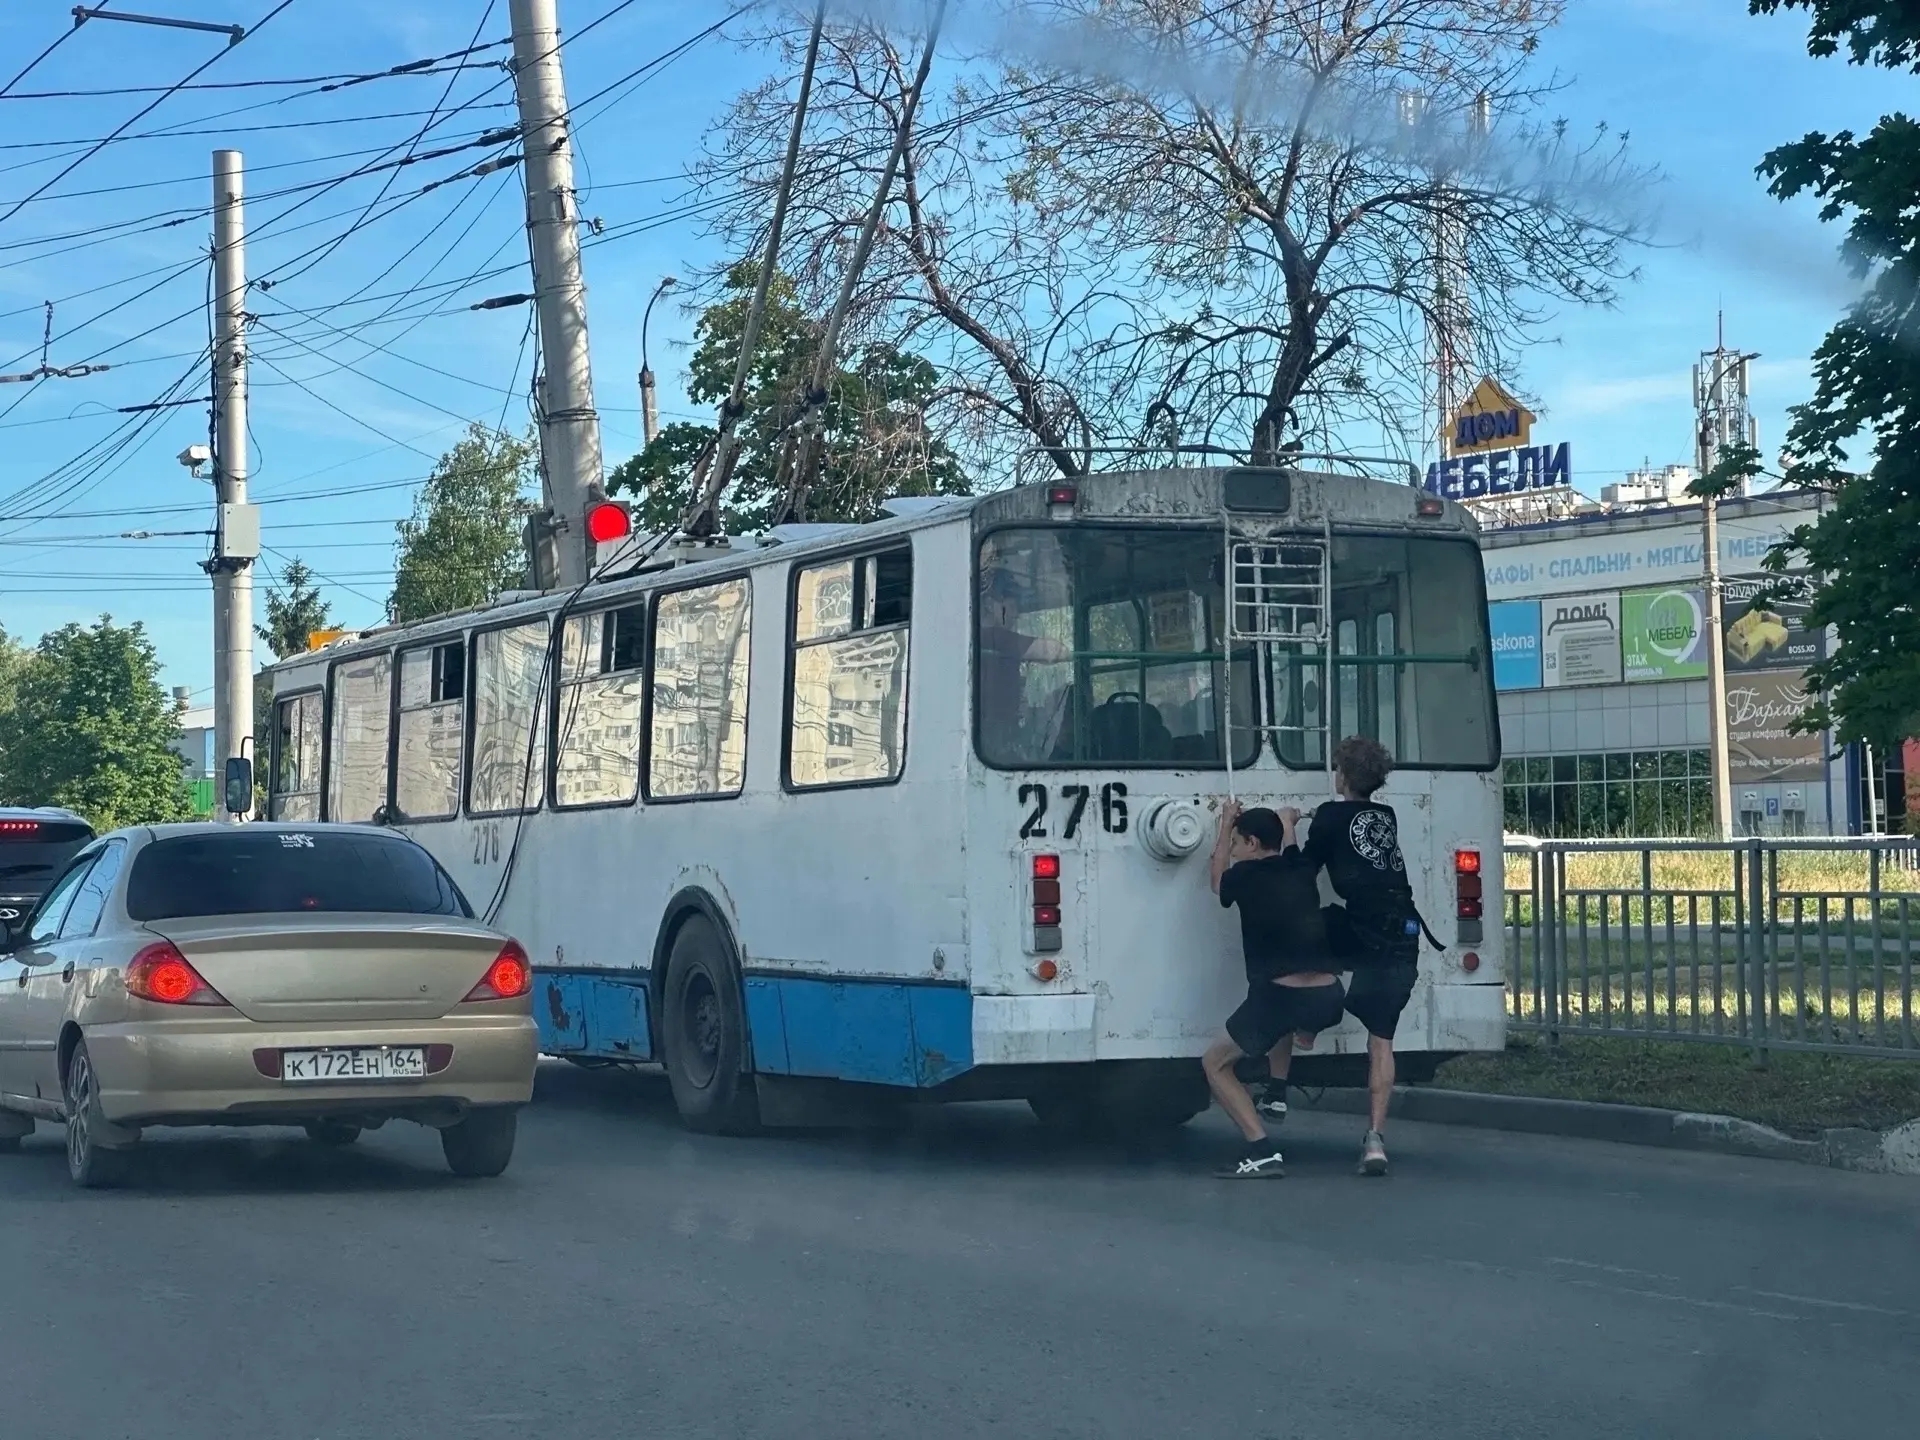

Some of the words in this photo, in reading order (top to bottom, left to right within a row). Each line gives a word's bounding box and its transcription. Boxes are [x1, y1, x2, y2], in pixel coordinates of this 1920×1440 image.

[1456, 410, 1519, 448] ДОМ
[1549, 552, 1631, 579] СПАЛЬНИ
[1728, 584, 1760, 599] DIVAN
[1648, 625, 1697, 642] МЕБЕЛЬ
[1634, 636, 1639, 653] 1
[1626, 653, 1648, 667] ЭТАЖ
[1018, 782, 1128, 839] 276
[384, 1050, 417, 1069] 164
